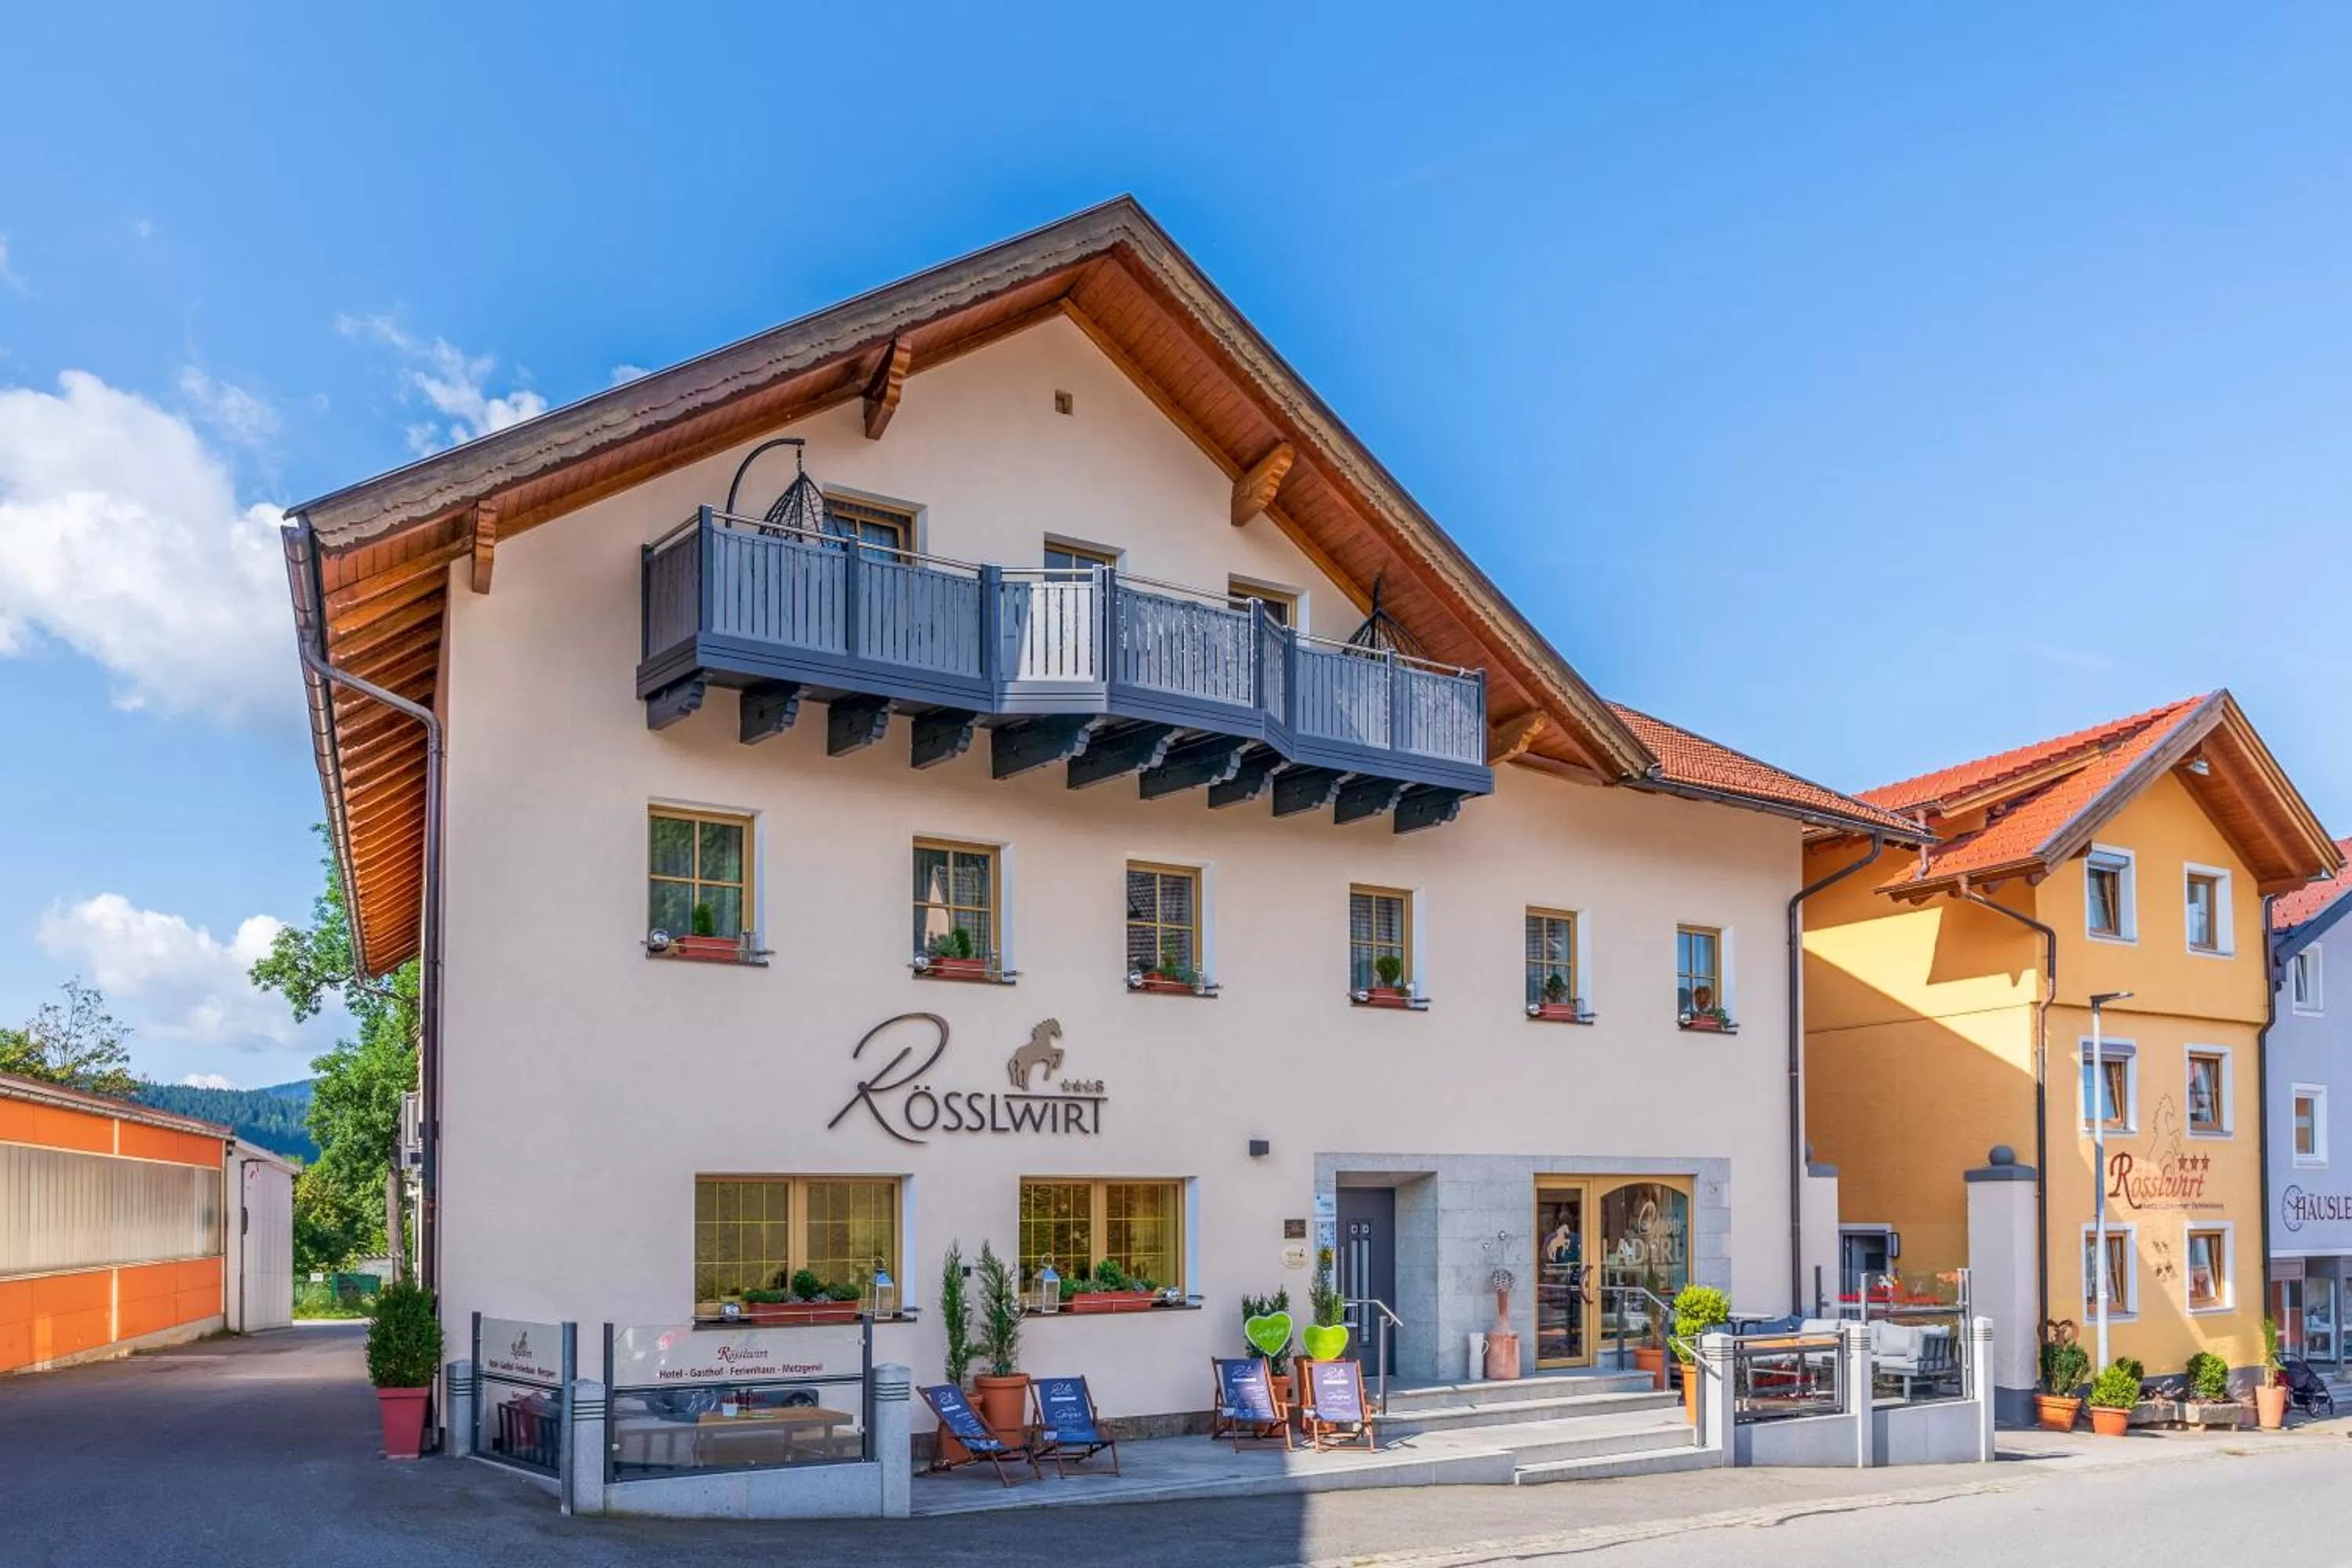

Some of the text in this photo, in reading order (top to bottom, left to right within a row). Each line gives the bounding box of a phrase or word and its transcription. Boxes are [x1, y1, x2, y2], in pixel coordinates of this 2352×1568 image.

[828, 1012, 1108, 1144] RÖSSLWIRT
[659, 1368, 683, 1379] Hotel
[690, 1367, 724, 1377] Gasthof
